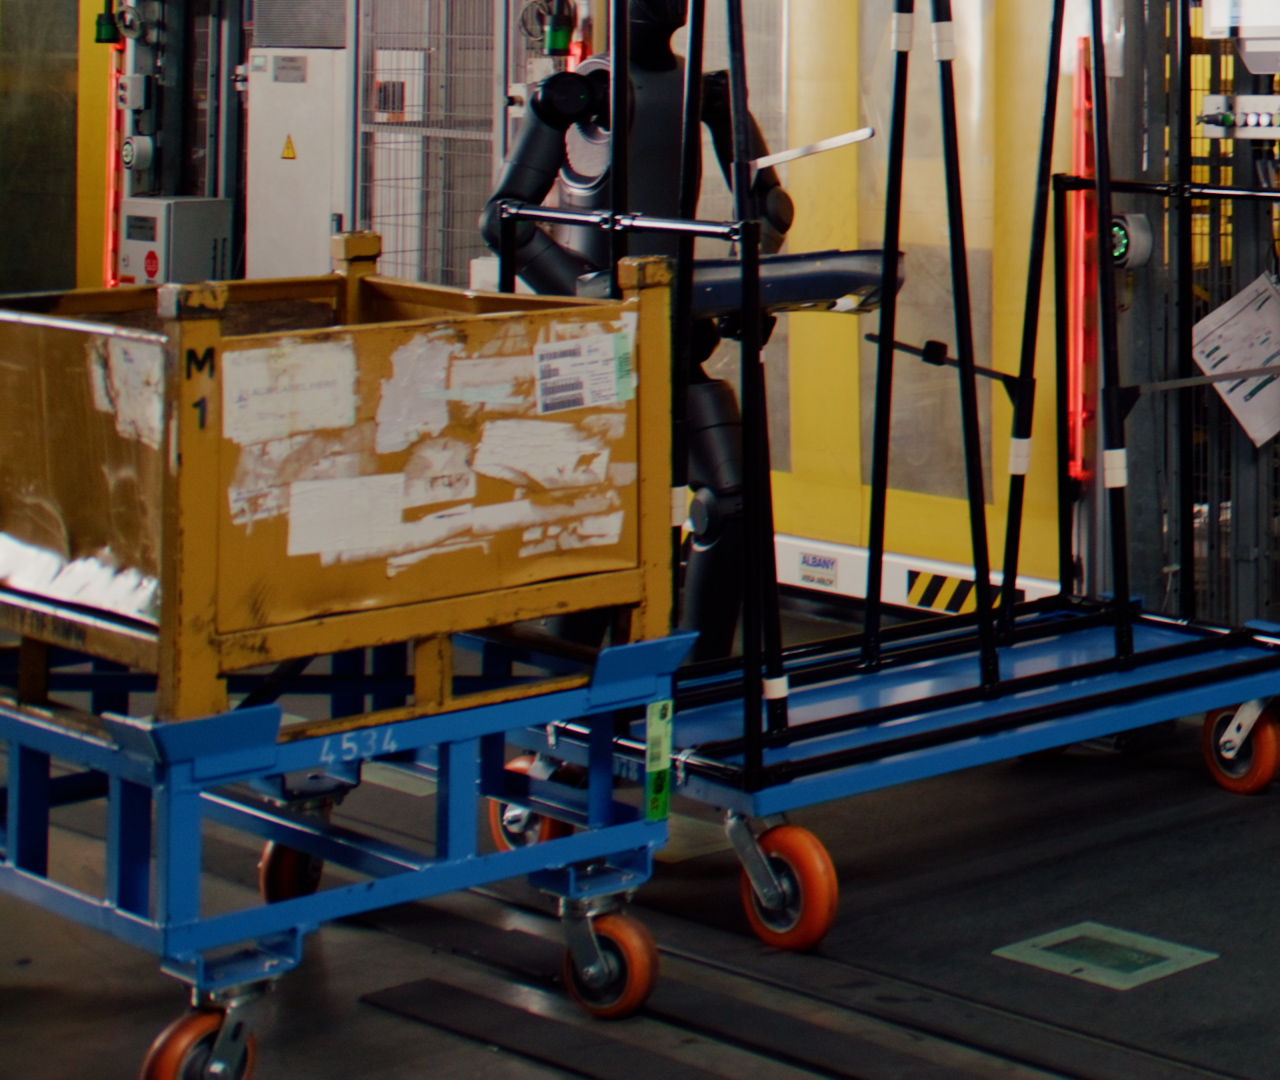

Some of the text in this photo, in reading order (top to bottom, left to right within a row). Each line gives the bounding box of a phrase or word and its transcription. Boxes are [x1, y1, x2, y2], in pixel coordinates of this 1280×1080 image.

[185, 346, 216, 381] M
[191, 396, 208, 430] 1
[319, 726, 399, 765] 4534
